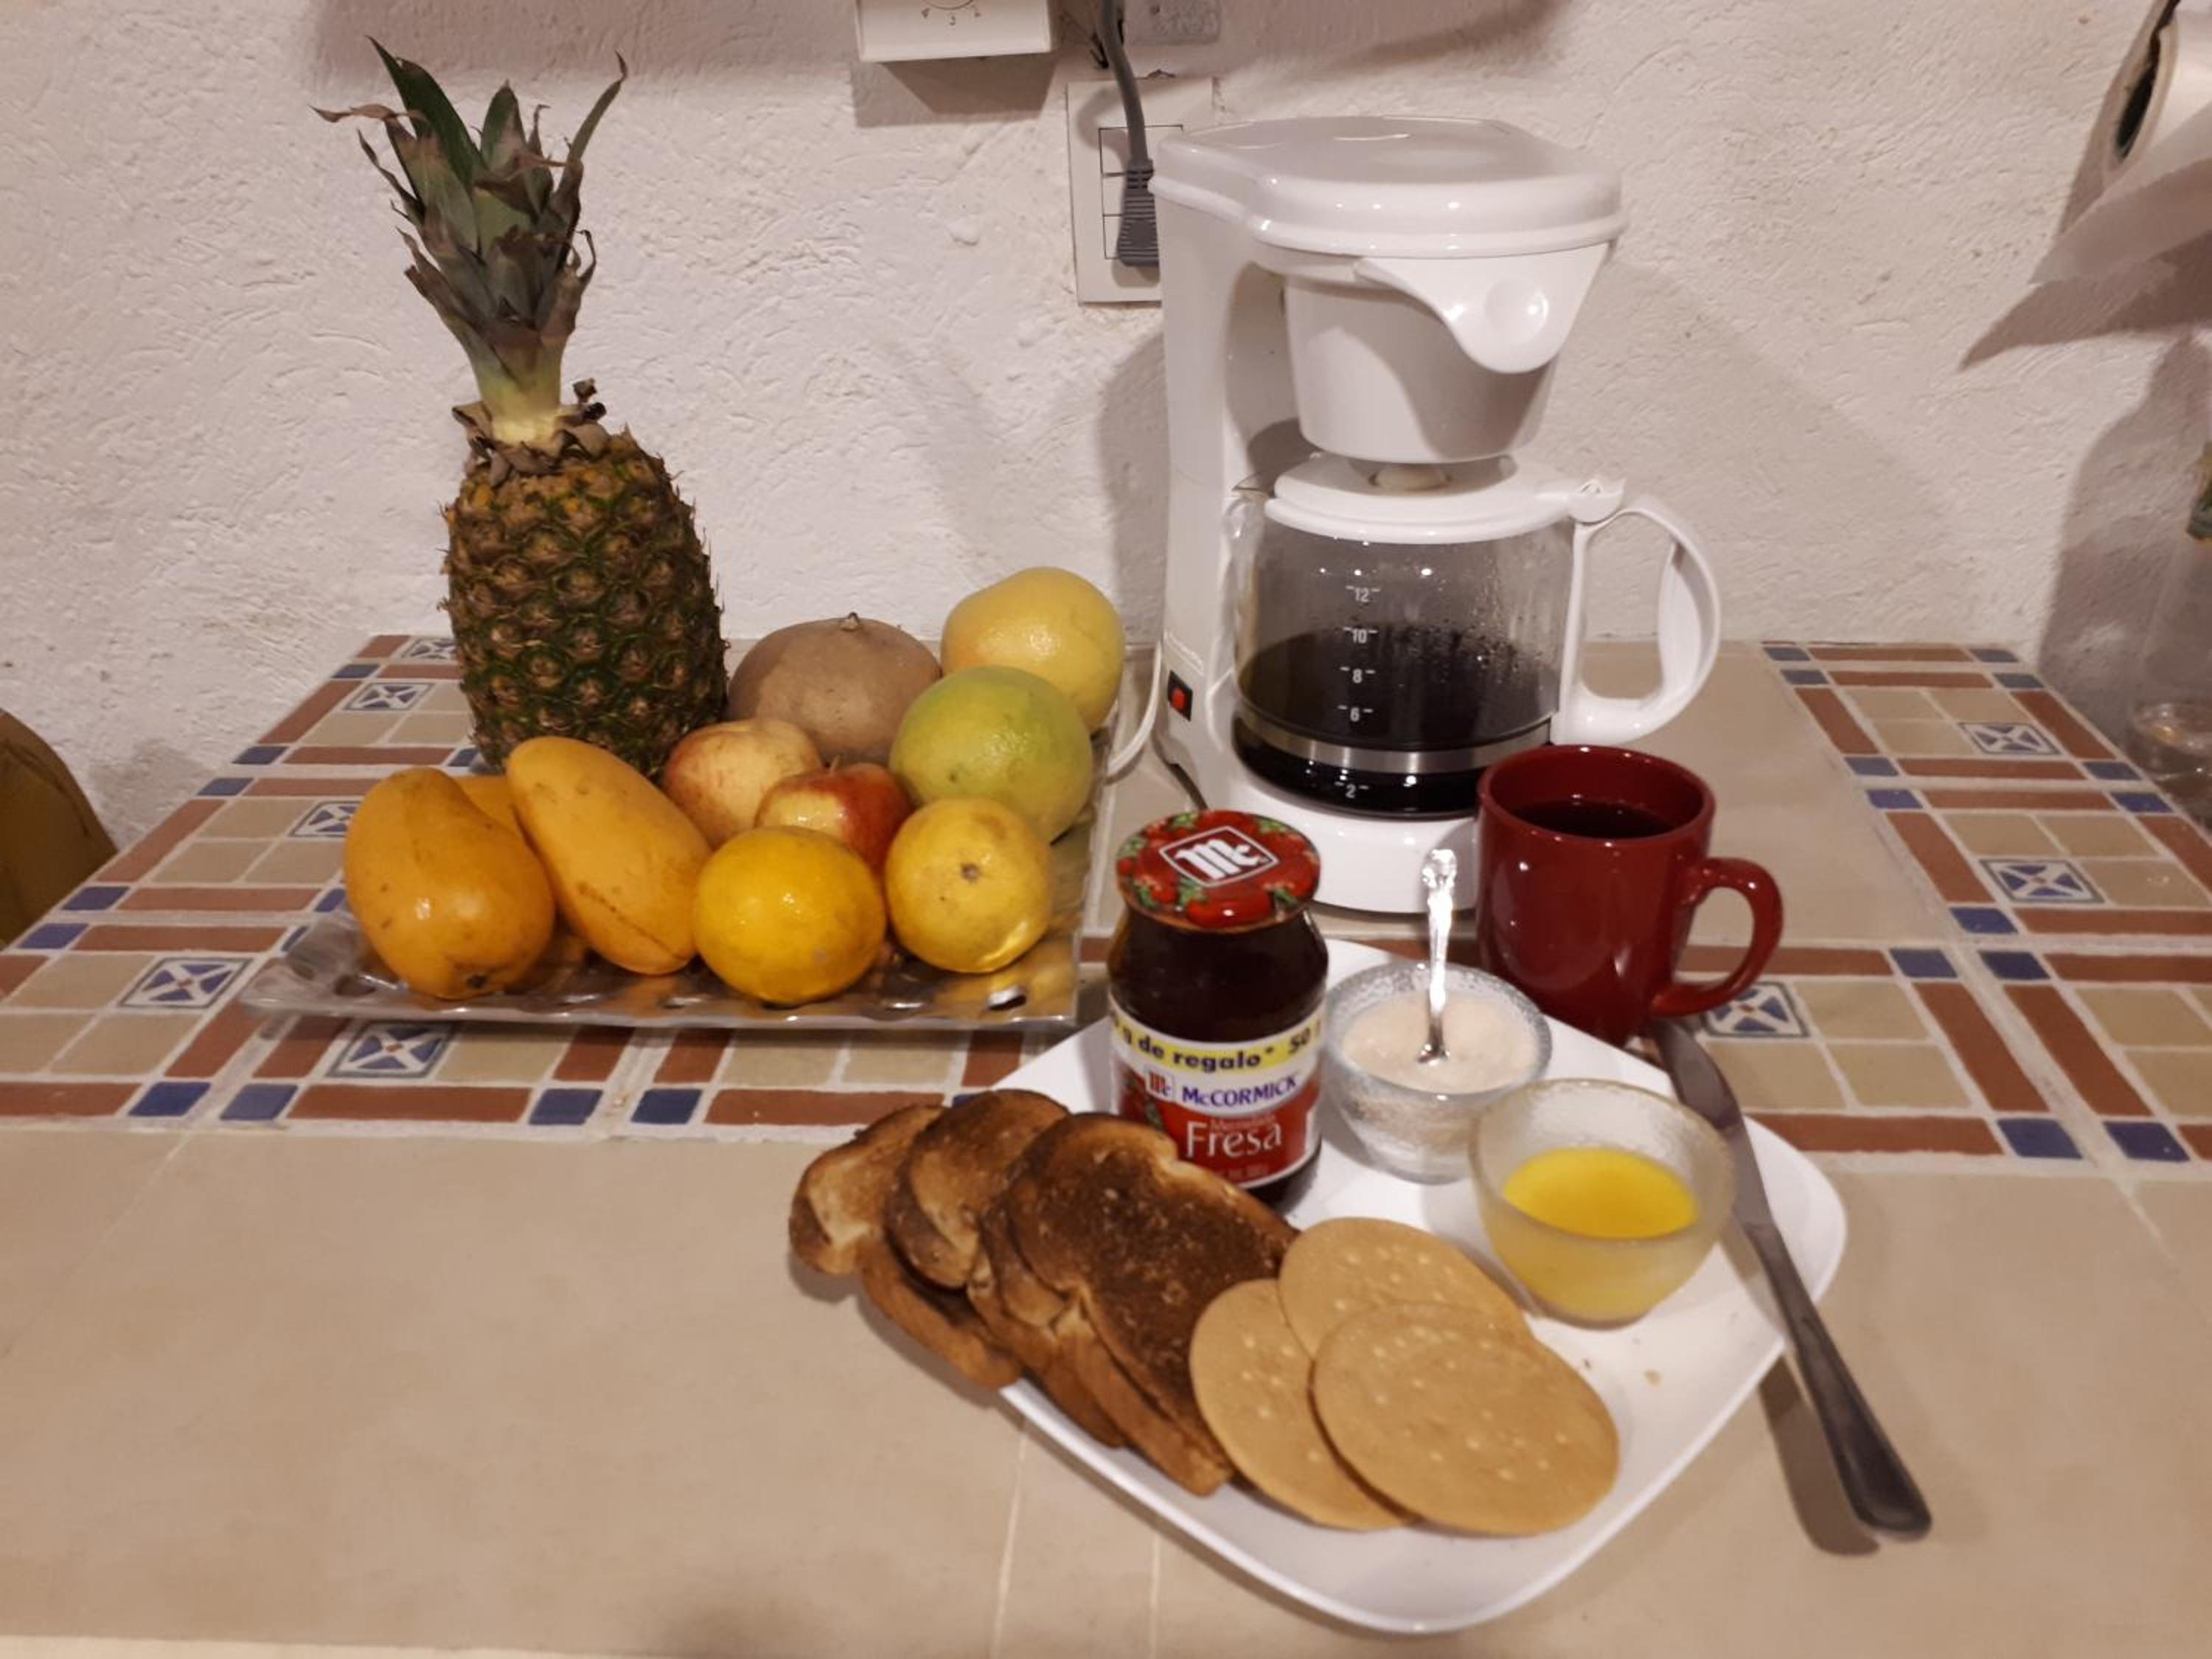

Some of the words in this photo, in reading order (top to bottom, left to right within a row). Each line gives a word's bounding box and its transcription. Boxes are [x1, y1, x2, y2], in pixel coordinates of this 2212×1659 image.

[1354, 587, 1369, 602] 12
[1352, 628, 1368, 644] 10
[1352, 668, 1363, 684] 8
[1350, 707, 1360, 722] 6
[1345, 784, 1356, 799] 2
[1138, 1034, 1164, 1060] de
[1182, 1077, 1296, 1107] McCORMICK
[1186, 1120, 1281, 1158] Fresa
